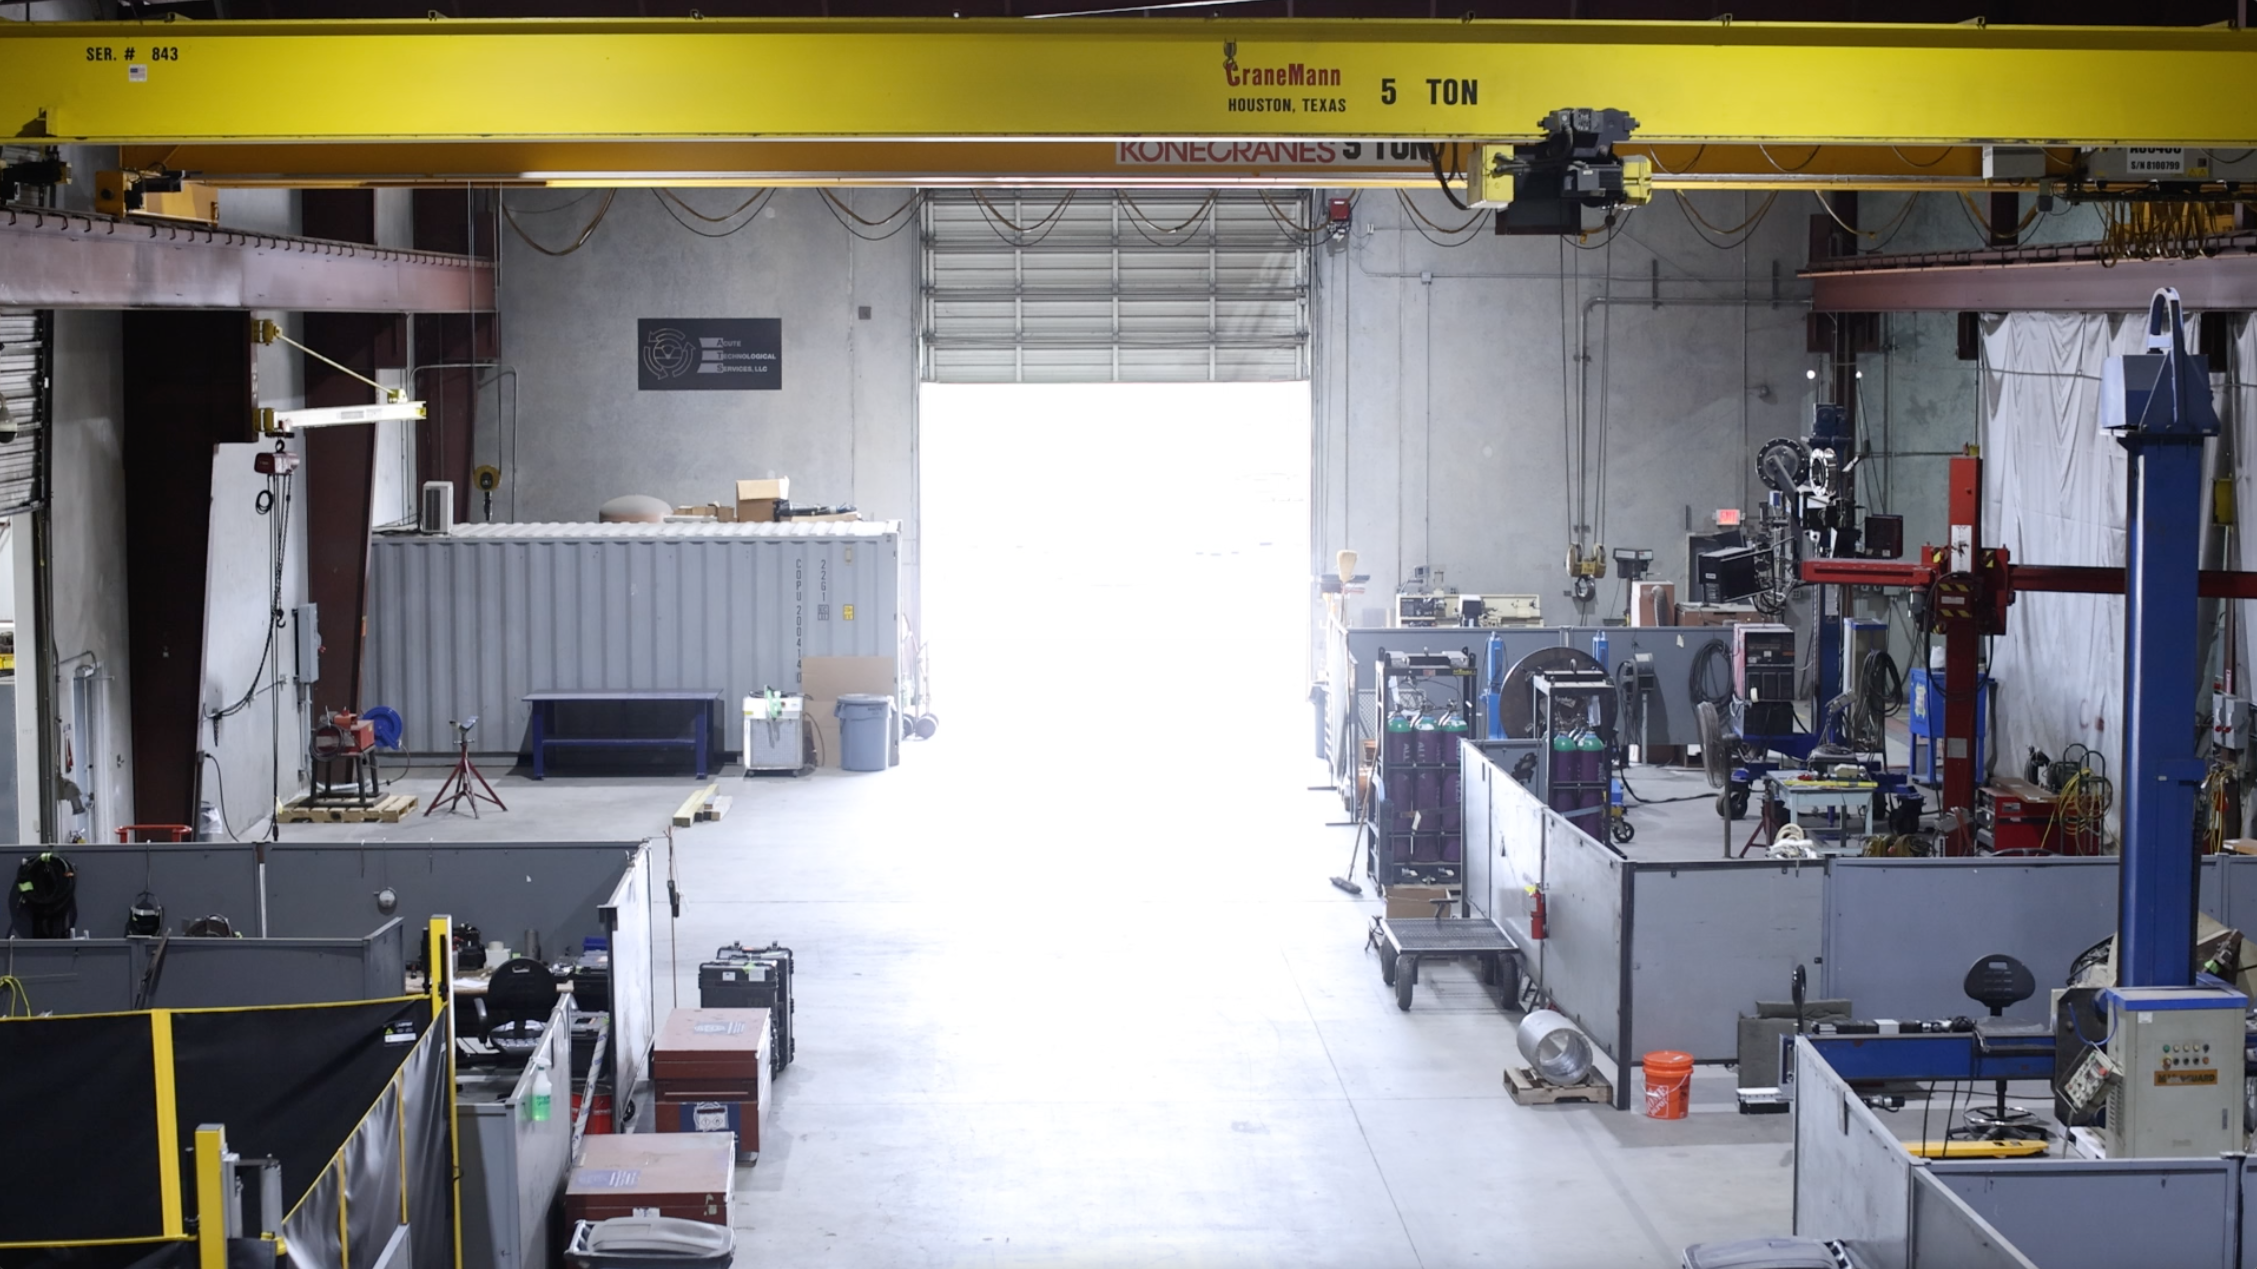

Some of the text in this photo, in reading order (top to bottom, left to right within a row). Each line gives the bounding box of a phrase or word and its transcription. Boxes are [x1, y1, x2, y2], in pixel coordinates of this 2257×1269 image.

[86, 47, 178, 61] SER. # 843
[1225, 63, 1341, 87] CraneMann
[1381, 78, 1478, 106] 5 TON
[1228, 98, 1347, 114] HOUSTON, TEXAS
[1120, 142, 1337, 163] KONECRANES
[2146, 161, 2180, 170] 8100799
[716, 352, 776, 360] TECHNOLOGICAL
